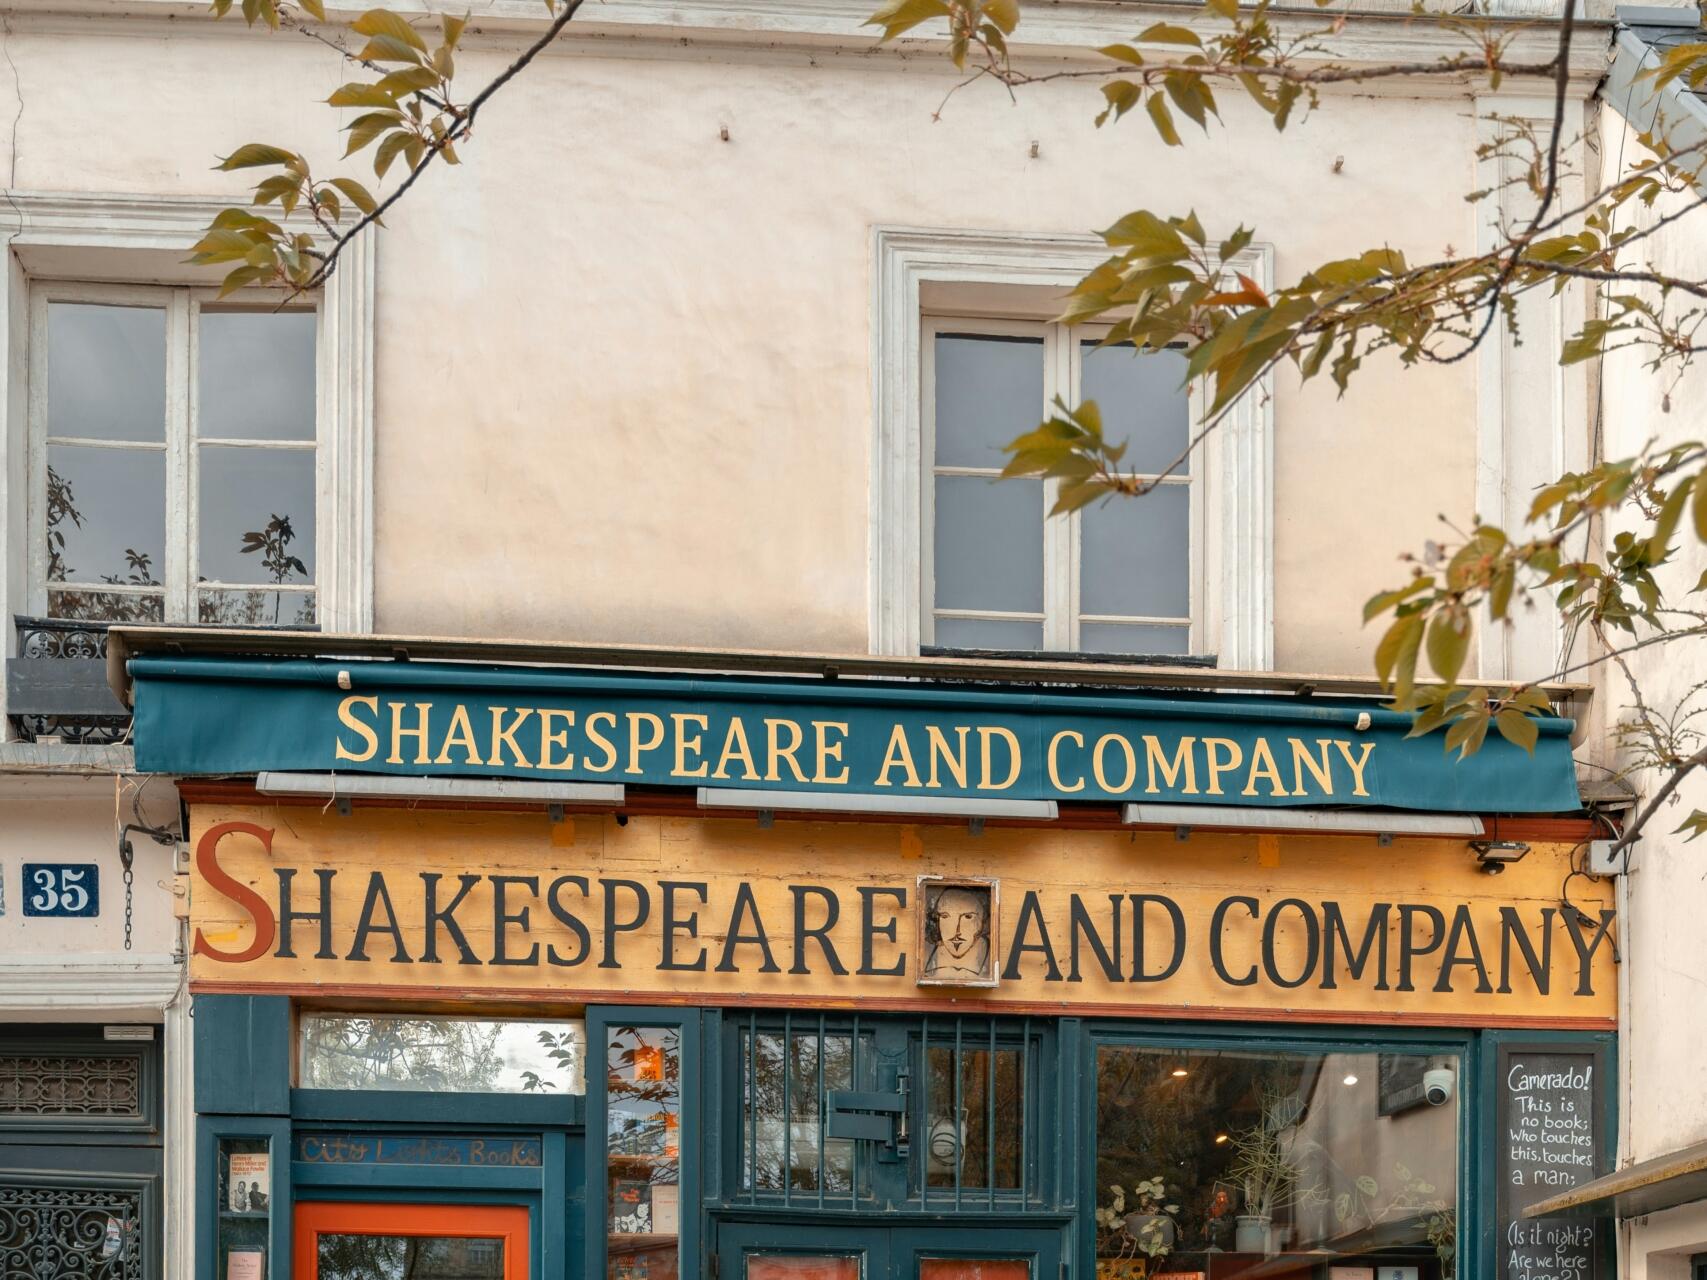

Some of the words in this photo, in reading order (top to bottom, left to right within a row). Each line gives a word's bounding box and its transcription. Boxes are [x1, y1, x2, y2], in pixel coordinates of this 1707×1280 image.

[335, 695, 850, 786] SHAKESPEARE
[874, 724, 1022, 790] AND
[1047, 730, 1376, 798] COMPANY
[33, 869, 88, 911] 35
[192, 821, 907, 977] SHAKESPEARE
[1001, 890, 1187, 984] AND
[1209, 895, 1616, 997] COMPANY
[1508, 1064, 1592, 1092] Camerado!
[1514, 1096, 1551, 1113] This
[1561, 1097, 1575, 1112] is
[1521, 1117, 1539, 1127] no
[1545, 1115, 1588, 1130] book;
[1510, 1129, 1537, 1142] Who
[1541, 1129, 1592, 1147] touches
[1511, 1147, 1541, 1162] this,
[1543, 1147, 1592, 1167] touches
[1512, 1170, 1524, 1185] a
[1534, 1170, 1576, 1186] man;
[1530, 1222, 1542, 1245] it
[1547, 1222, 1593, 1253] night?
[1508, 1250, 1532, 1269] Are
[1536, 1255, 1553, 1267] we
[1555, 1252, 1587, 1269] here
